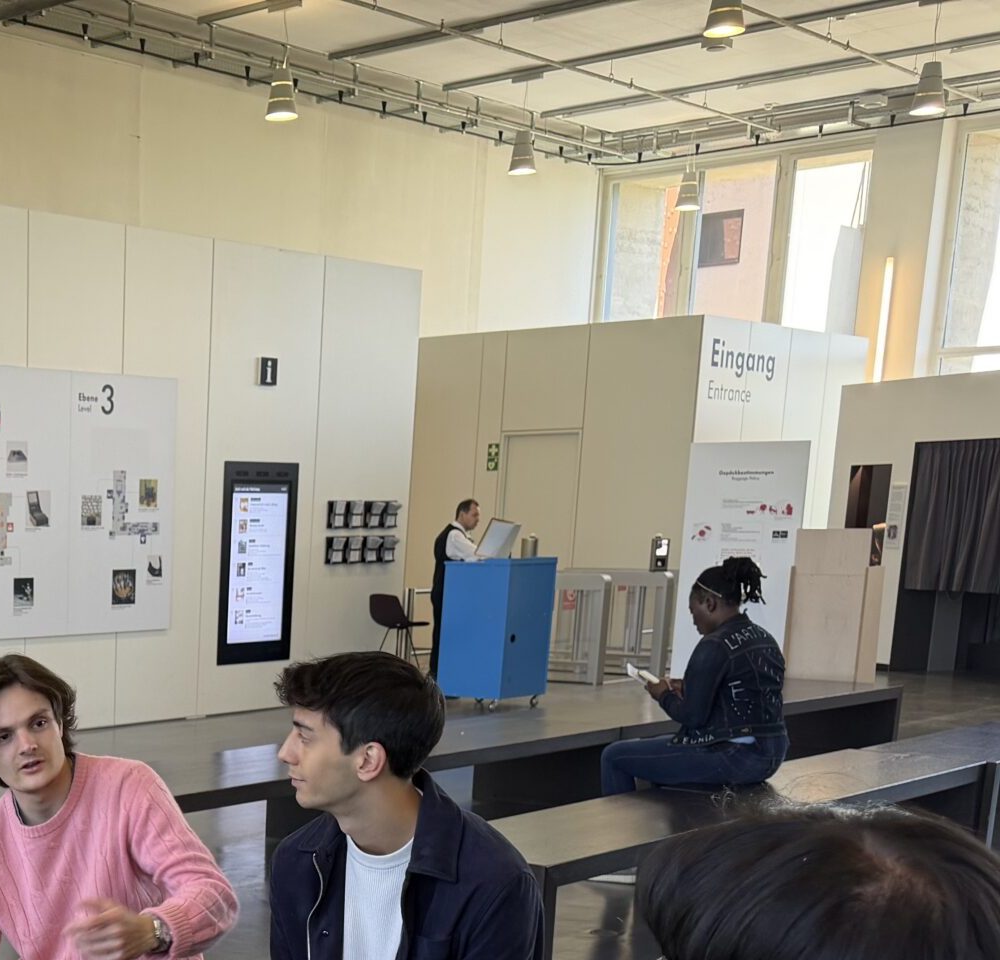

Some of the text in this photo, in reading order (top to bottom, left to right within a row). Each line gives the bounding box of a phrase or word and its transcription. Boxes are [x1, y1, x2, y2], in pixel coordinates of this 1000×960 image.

[711, 338, 776, 381] Eingang
[78, 384, 114, 415] Ebene 3
[707, 380, 752, 403] Entrance
[78, 404, 92, 413] Level
